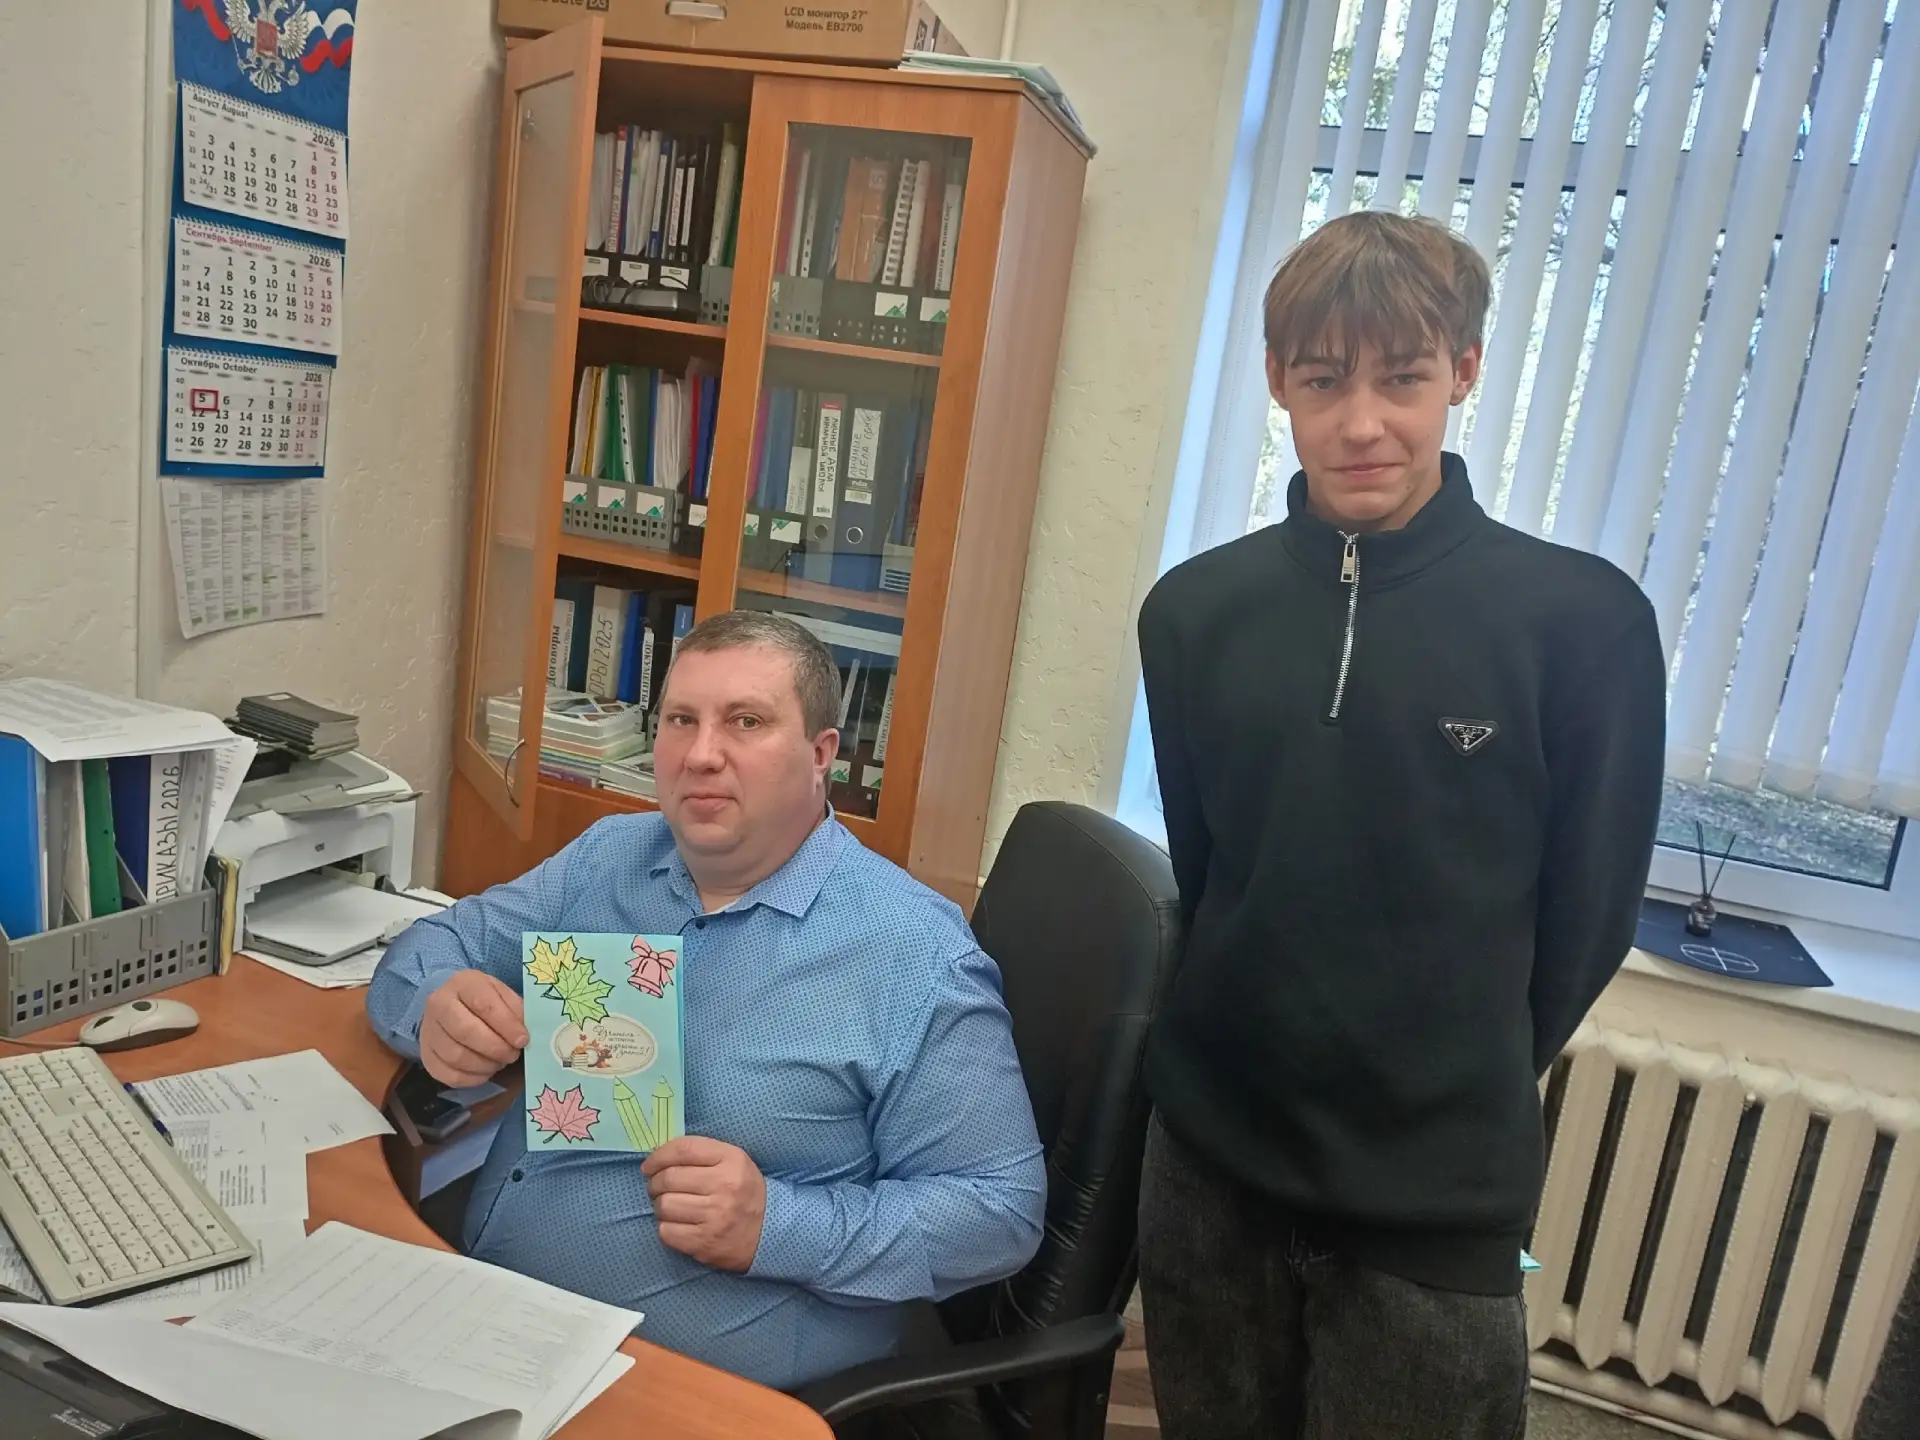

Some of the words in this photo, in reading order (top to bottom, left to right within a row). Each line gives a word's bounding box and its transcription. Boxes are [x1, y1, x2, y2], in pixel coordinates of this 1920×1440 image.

[784, 6, 805, 17] LCD
[806, 9, 850, 20] монитор
[786, 19, 824, 30] Модель
[826, 21, 863, 32] EB2700
[193, 94, 219, 109] Август
[222, 103, 248, 118] August
[312, 134, 335, 147] 2026
[208, 135, 214, 145] 3
[229, 142, 235, 151] 4
[251, 148, 256, 157] 5
[270, 154, 276, 163] 6
[311, 166, 316, 174] 8
[332, 172, 336, 180] 9
[313, 152, 317, 161] 1
[331, 157, 336, 166] 2
[202, 149, 214, 160] 10
[224, 156, 235, 167] 11
[244, 162, 256, 172] 12
[265, 168, 276, 178] 13
[285, 173, 296, 183] 14
[306, 179, 316, 188] 15
[325, 184, 337, 194] 16
[202, 164, 214, 175] 17
[224, 171, 235, 182] 18
[245, 177, 256, 187] 19
[265, 182, 277, 193] 20
[286, 188, 296, 198] 21
[306, 194, 317, 203] 22
[326, 198, 337, 208] 23
[224, 186, 236, 197] 25
[245, 192, 257, 202] 26
[266, 198, 277, 207] 27
[286, 203, 297, 212] 28
[306, 208, 318, 217] 29
[326, 212, 338, 222] 30
[186, 228, 226, 243] Сентябрь
[230, 237, 272, 252] September
[228, 256, 232, 266] 1
[250, 261, 256, 270] 2
[272, 265, 277, 274] 3
[291, 268, 296, 278] 4
[309, 273, 313, 282] 5
[327, 277, 332, 286] 6
[309, 255, 330, 267] 2026
[204, 267, 210, 276] 7
[227, 272, 233, 281] 8
[250, 275, 256, 285] 9
[266, 279, 278, 289] 10
[286, 283, 296, 293] 11
[303, 287, 314, 296] 12
[321, 290, 332, 299] 13
[197, 282, 210, 292] 14
[220, 285, 233, 296] 15
[244, 290, 256, 300] 16
[267, 293, 277, 303] 17
[286, 297, 296, 307] 18
[304, 301, 314, 309] 19
[321, 304, 332, 313] 20
[197, 297, 210, 307] 21
[220, 300, 233, 310] 22
[244, 304, 256, 314] 23
[266, 308, 277, 318] 24
[286, 311, 296, 321] 25
[304, 315, 314, 324] 26
[321, 318, 331, 327] 27
[197, 312, 210, 322] 28
[220, 315, 233, 325] 29
[244, 318, 257, 329] 30
[181, 358, 220, 370] Октябрь
[223, 363, 257, 374] October
[305, 372, 322, 382] 2026
[270, 387, 274, 396] 1
[288, 389, 293, 397] 2
[199, 394, 206, 403] 5
[223, 396, 230, 405] 6
[248, 399, 254, 407] 7
[269, 401, 274, 409] 8
[287, 403, 292, 411] 9
[215, 410, 229, 419] 13
[240, 413, 252, 421] 14
[262, 414, 273, 423] 15
[281, 416, 291, 425] 16
[192, 422, 204, 432] 19
[215, 425, 228, 434] 20
[239, 426, 251, 436] 21
[261, 428, 272, 437] 22
[280, 429, 290, 438] 23
[190, 437, 204, 447] 26
[215, 438, 227, 448] 27
[238, 440, 251, 449] 28
[261, 442, 271, 451] 29
[279, 443, 288, 452] 30
[826, 456, 836, 483] ДЕЛА
[594, 614, 613, 659] 2025
[547, 625, 560, 688] Договоры
